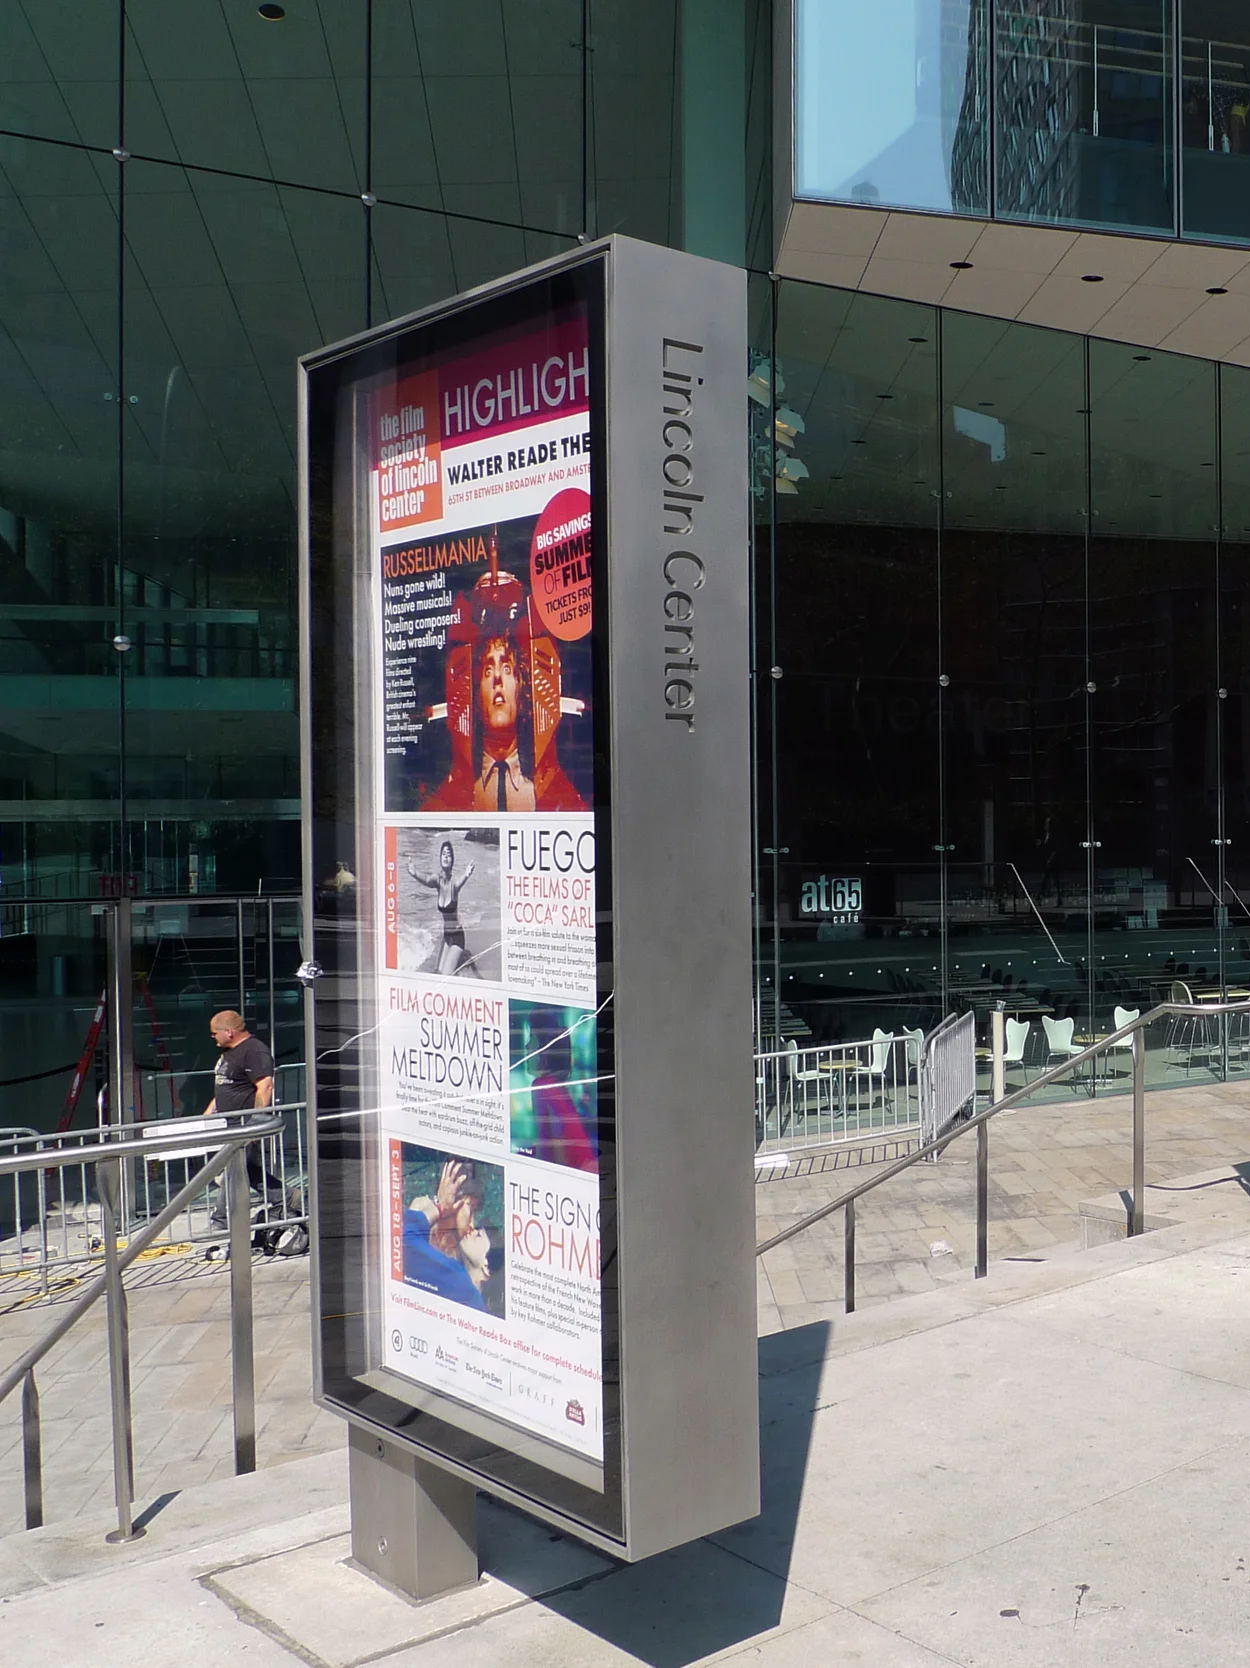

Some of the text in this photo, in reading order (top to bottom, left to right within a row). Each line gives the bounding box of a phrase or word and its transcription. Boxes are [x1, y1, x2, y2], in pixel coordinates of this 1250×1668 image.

[444, 347, 589, 436] HIGHLIGH
[381, 405, 425, 441] the film
[381, 434, 426, 469] society
[447, 432, 590, 486] WALTER READE THE
[381, 457, 438, 497] of lincoln
[448, 489, 464, 505] 65TH
[465, 490, 473, 502] ST
[474, 482, 504, 499] BETWEEN
[505, 473, 547, 492] BROADWAY
[548, 470, 565, 483] AND
[382, 489, 425, 522] center
[537, 530, 553, 550] BIG
[662, 337, 706, 734] Lincoln Center
[383, 536, 488, 580] RUSSELLMANIA
[384, 571, 446, 599] Nuns gone wild!
[544, 568, 560, 595] OF
[384, 590, 452, 617] Massive musicals!
[545, 592, 577, 615] TICKETS
[559, 602, 591, 625] JUST $9!
[385, 608, 461, 635] Dueling composers!
[386, 629, 446, 652] Nude wrestling!
[508, 829, 595, 874] FUEGO
[506, 876, 591, 901] THE FILMS OF
[387, 899, 396, 934] AUG
[562, 905, 594, 929] SARL
[833, 912, 859, 924] café
[389, 986, 503, 1026] FILM COMMENT
[420, 1017, 503, 1062] SUMMER
[391, 1044, 503, 1094] MELTDOWN
[509, 1181, 591, 1232] THE SIGN
[393, 1235, 401, 1273] AUG
[390, 1292, 403, 1305] Visit
[439, 1312, 446, 1321] or
[446, 1313, 457, 1326] The
[458, 1317, 478, 1333] Walter
[479, 1326, 498, 1341] Reade
[499, 1333, 512, 1347] Box
[513, 1339, 530, 1354] office
[531, 1344, 541, 1358] for
[542, 1350, 572, 1371] complete
